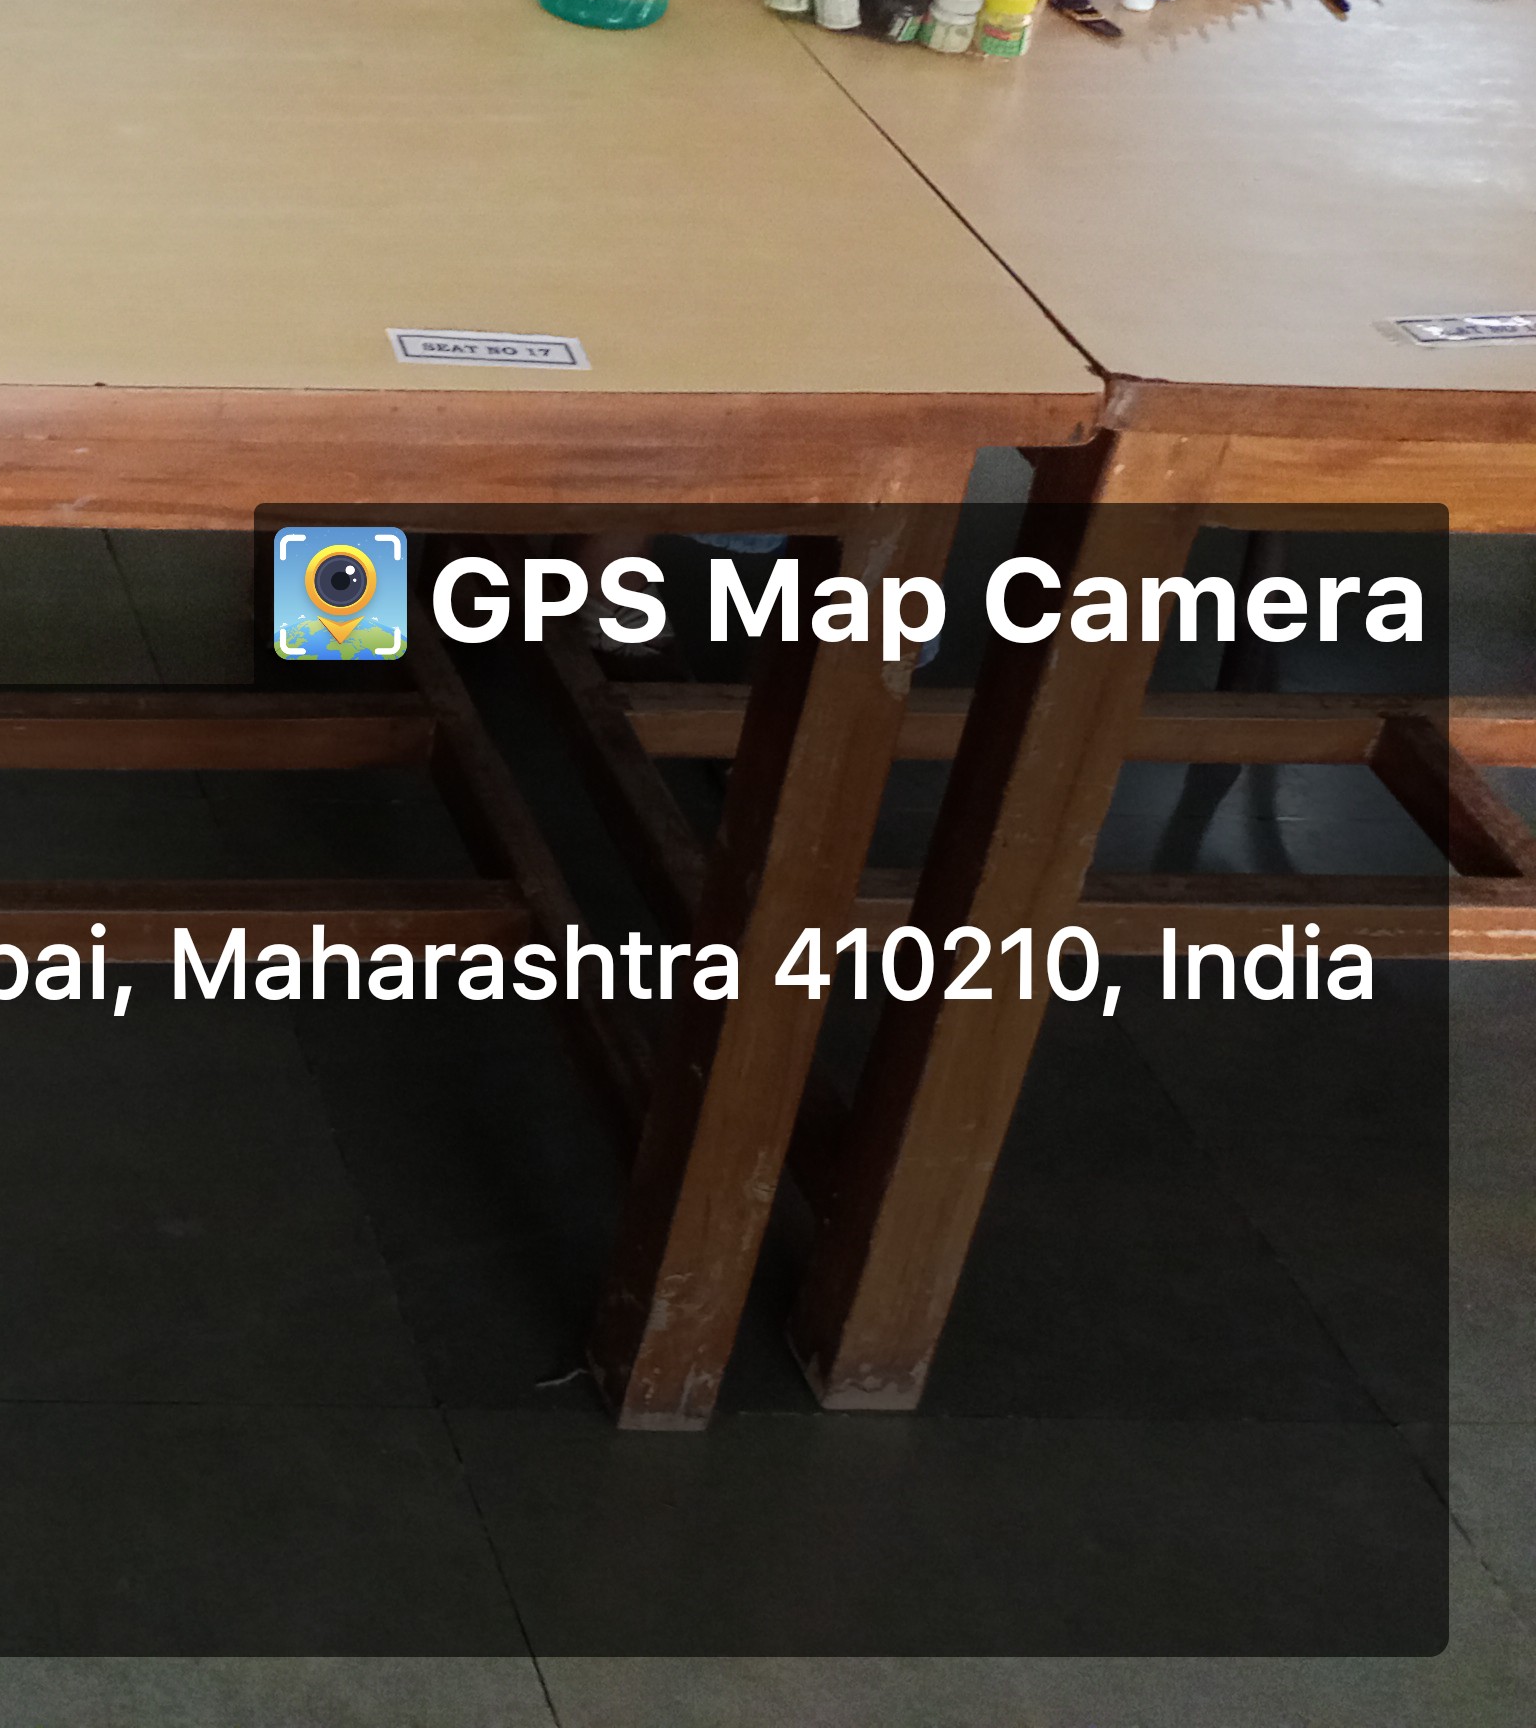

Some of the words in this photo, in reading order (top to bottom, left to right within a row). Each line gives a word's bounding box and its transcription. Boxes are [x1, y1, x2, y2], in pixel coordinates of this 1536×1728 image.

[421, 341, 480, 354] SEAT
[487, 345, 519, 356] NO
[526, 347, 551, 357] 17
